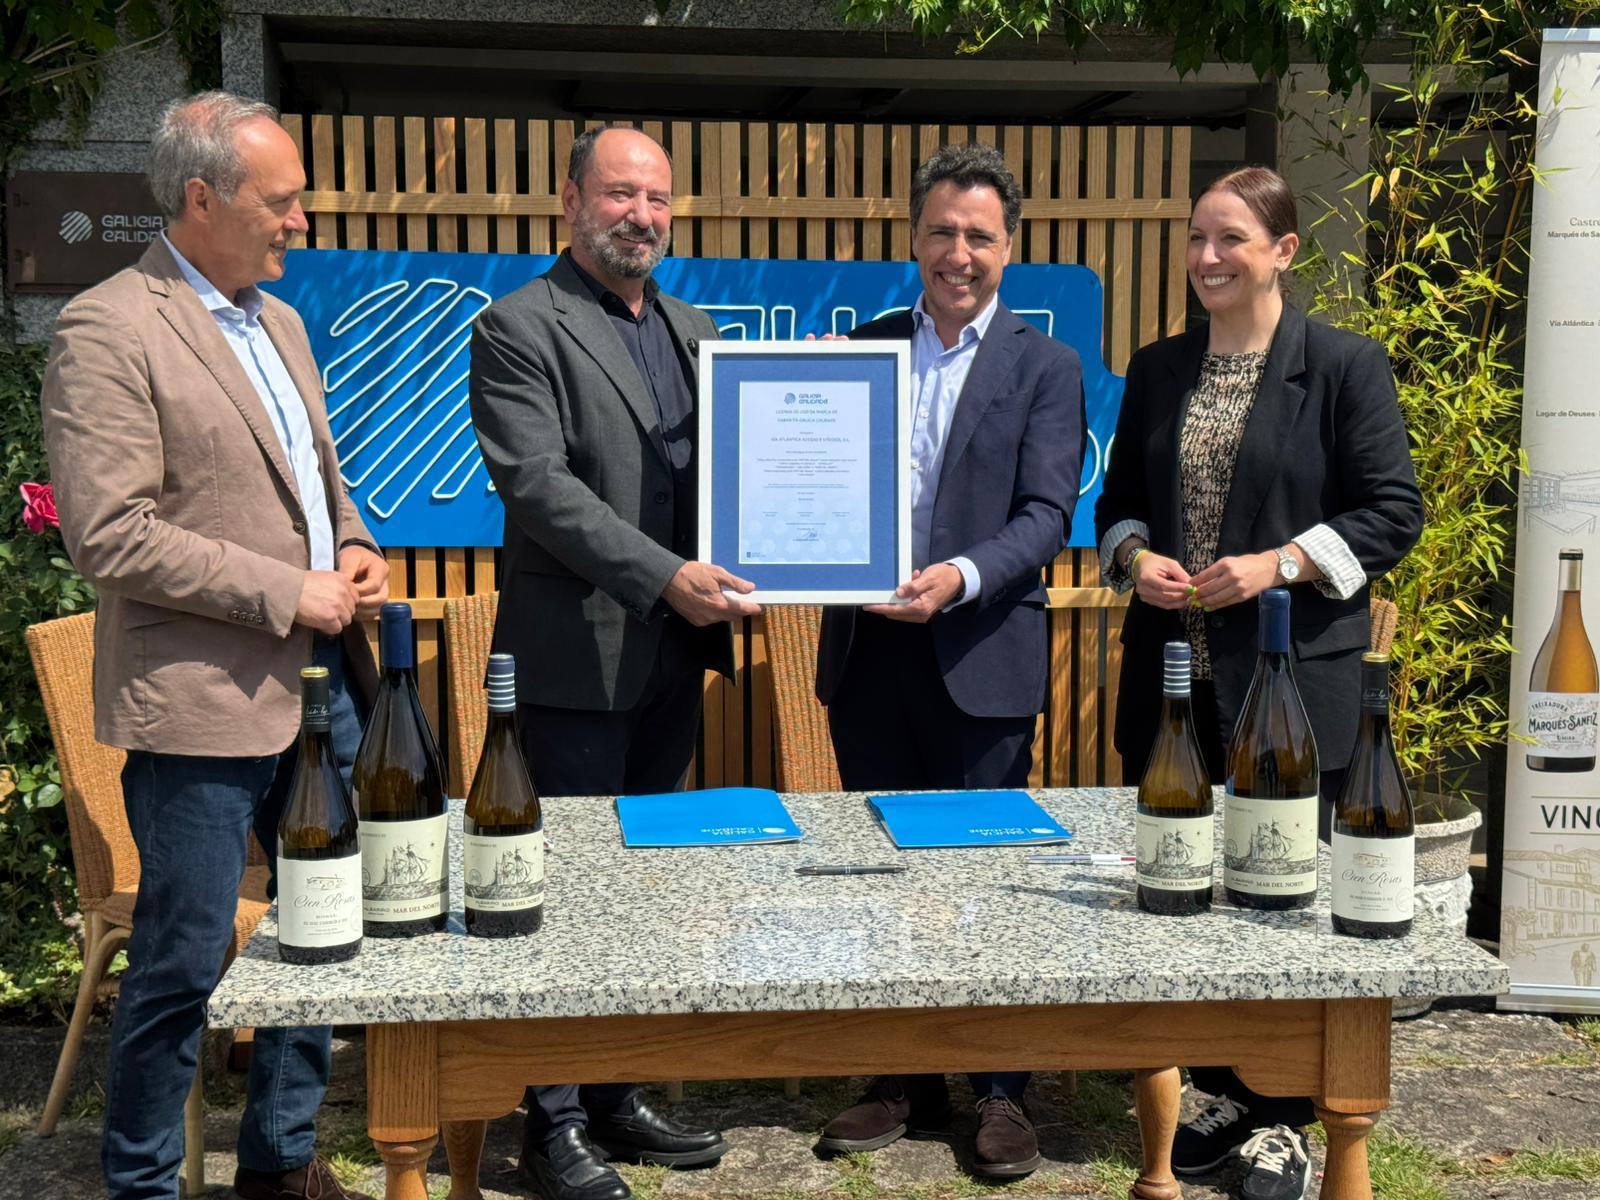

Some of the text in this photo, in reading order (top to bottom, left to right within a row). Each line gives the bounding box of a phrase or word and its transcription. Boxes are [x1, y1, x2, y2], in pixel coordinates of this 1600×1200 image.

[101, 215, 163, 228] GALICIA
[1535, 410, 1557, 418] Lagar
[1567, 712, 1598, 731] SANFIZ
[1540, 804, 1600, 829] VIN
